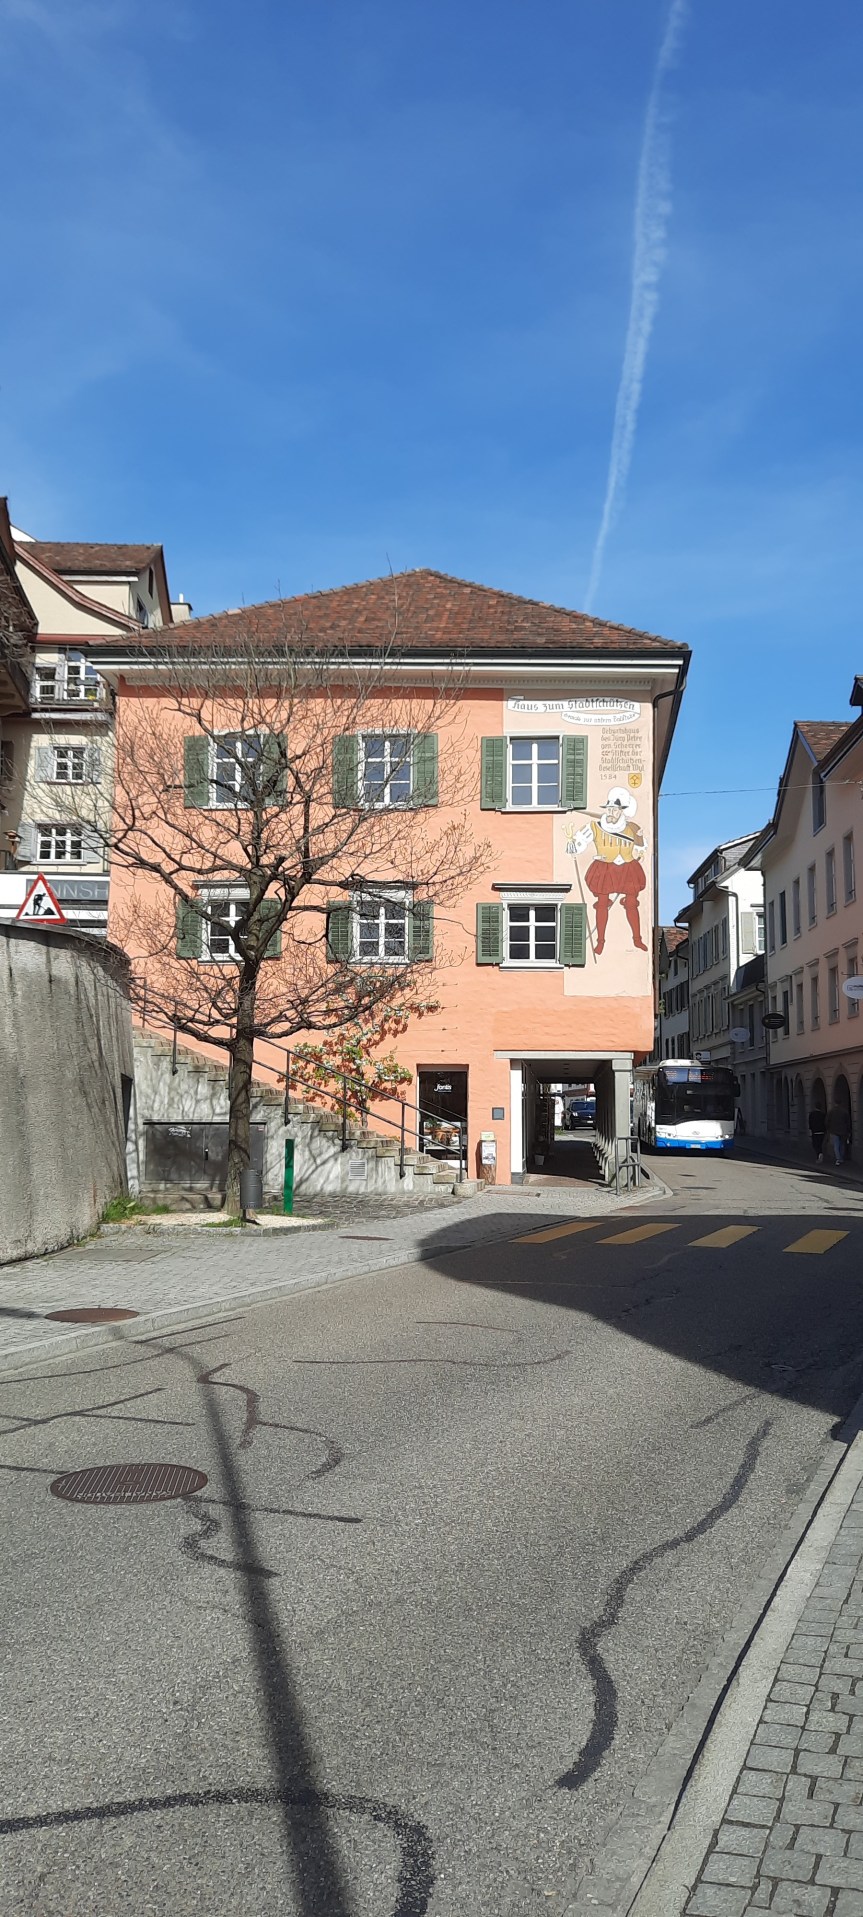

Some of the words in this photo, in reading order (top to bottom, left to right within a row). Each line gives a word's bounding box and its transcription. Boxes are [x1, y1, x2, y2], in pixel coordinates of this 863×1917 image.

[512, 700, 538, 711] Haus
[542, 703, 564, 712] zum
[601, 727, 640, 735] Geburtshaus
[49, 881, 108, 899] NNSH
